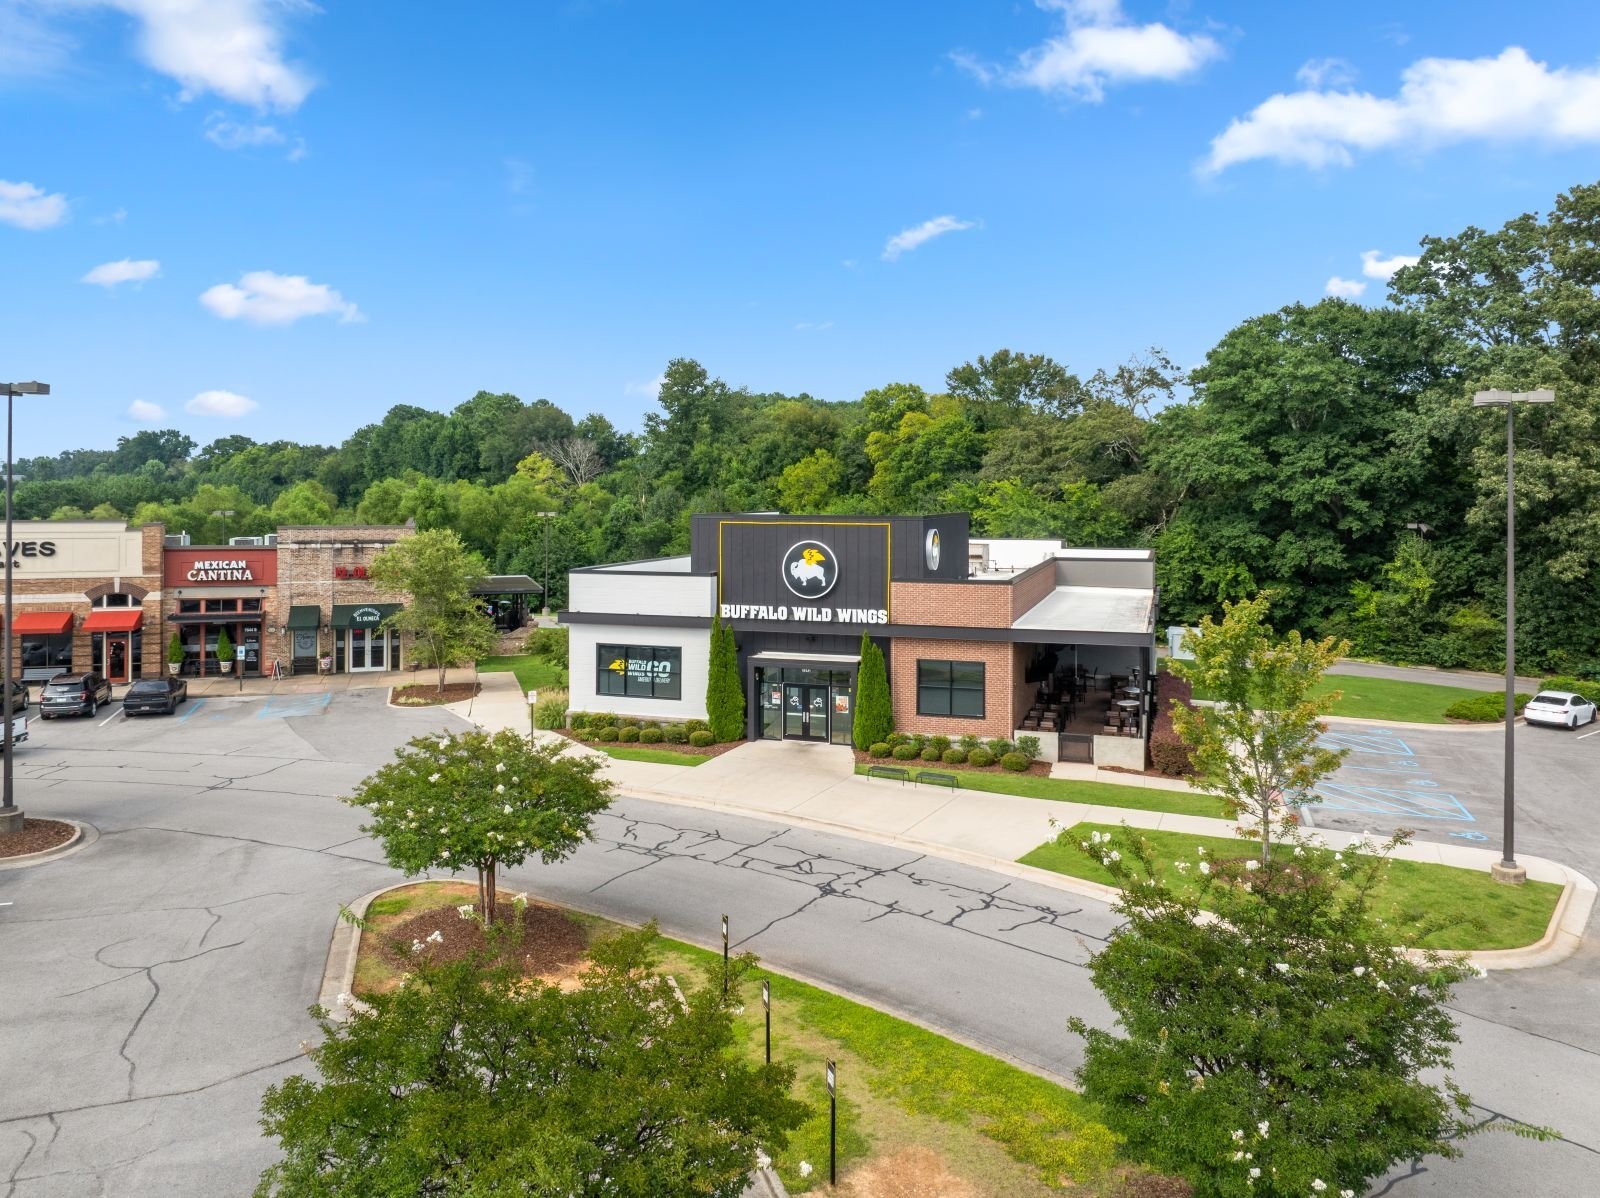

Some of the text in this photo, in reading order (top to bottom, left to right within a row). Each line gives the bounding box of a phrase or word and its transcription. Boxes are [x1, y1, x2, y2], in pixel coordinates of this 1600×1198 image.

[0, 541, 56, 557] VES
[194, 560, 246, 569] MEXICAN
[187, 569, 253, 581] CANTINA
[720, 604, 888, 624] BUFFALO WILD WINGS
[646, 660, 671, 678] GO
